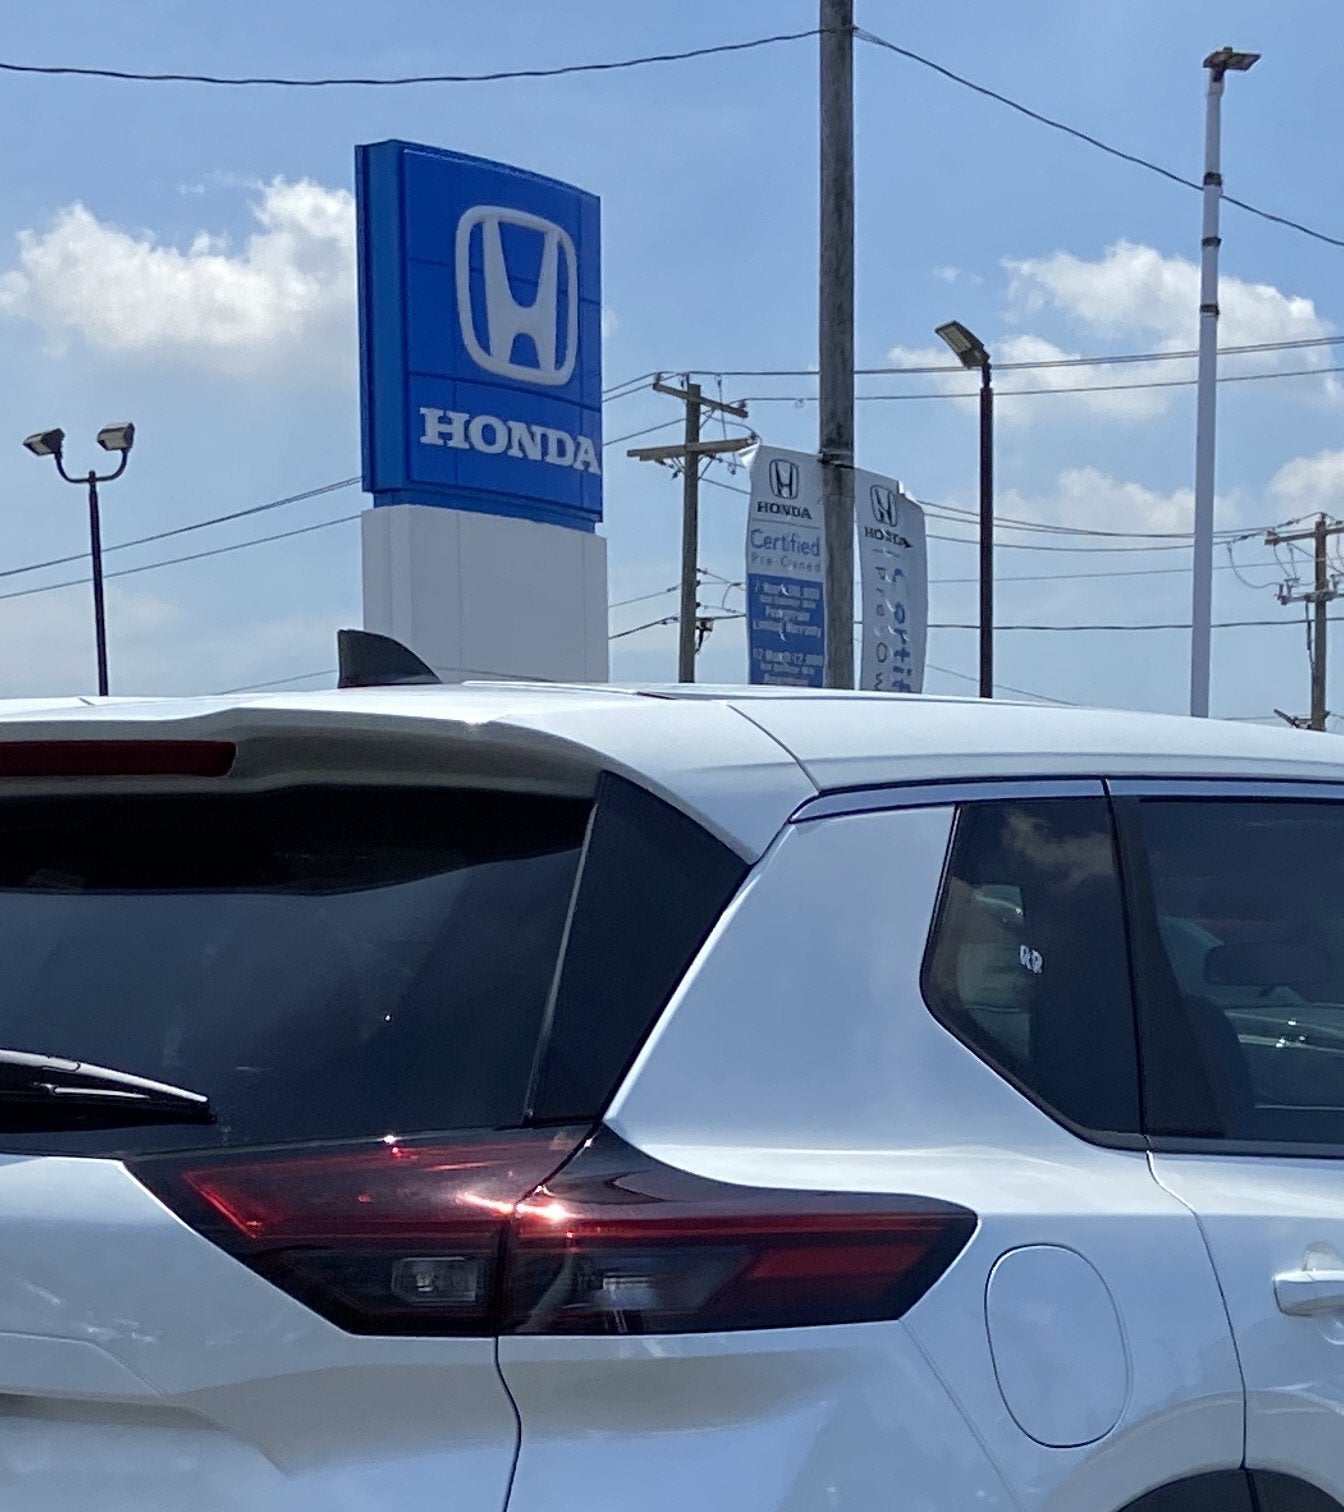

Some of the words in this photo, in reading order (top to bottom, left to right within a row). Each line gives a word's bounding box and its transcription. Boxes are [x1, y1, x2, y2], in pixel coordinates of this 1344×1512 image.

[420, 407, 601, 475] HONDA
[757, 501, 813, 520] HONDA
[751, 528, 820, 557] Certified
